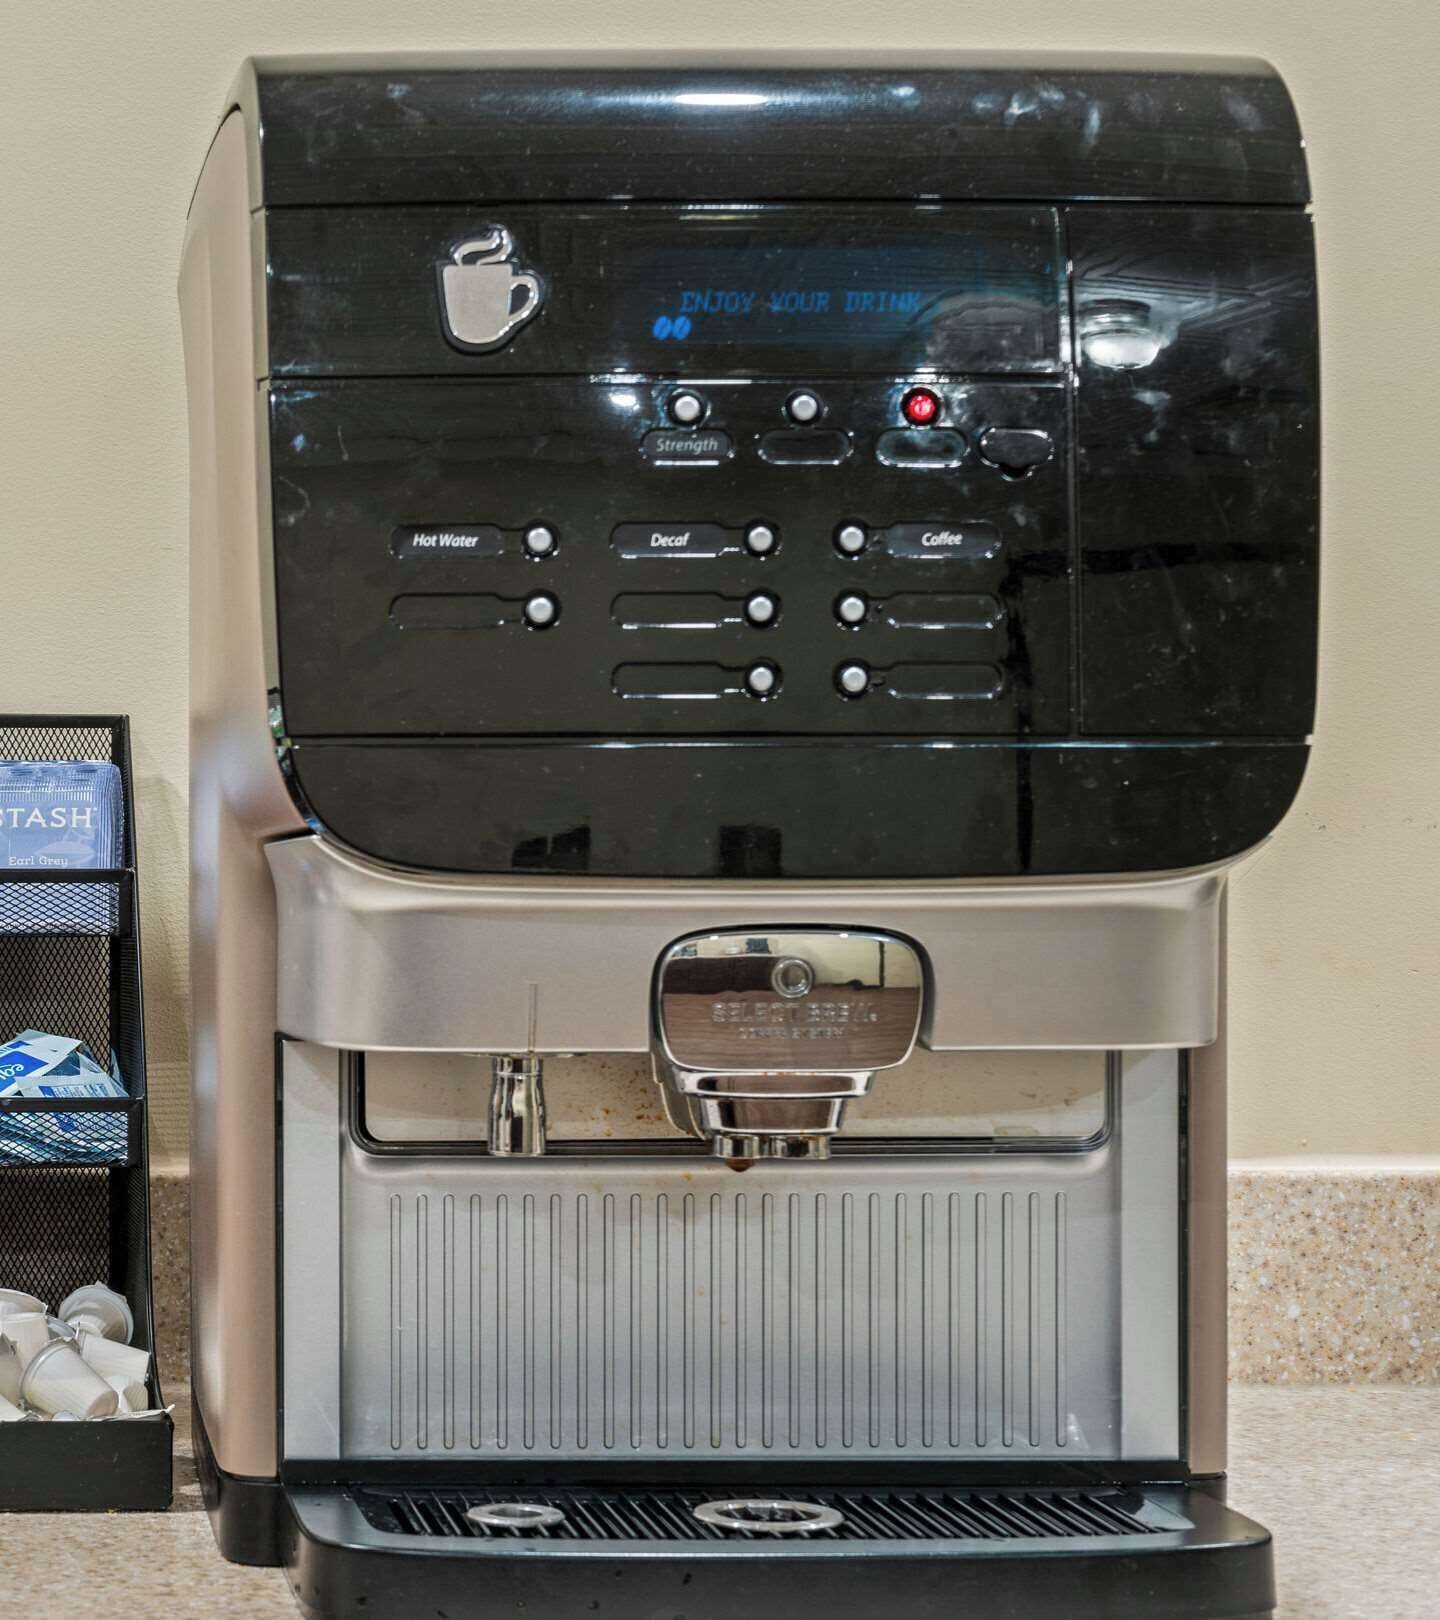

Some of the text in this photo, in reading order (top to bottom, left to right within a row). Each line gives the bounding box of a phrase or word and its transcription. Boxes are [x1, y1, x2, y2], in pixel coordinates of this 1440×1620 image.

[680, 291, 920, 313] ENJOY YOUR DRINK
[656, 437, 718, 454] Strength
[413, 532, 479, 547] Hot Water
[650, 532, 691, 547] Decaf
[921, 530, 963, 547] Coffee
[8, 856, 68, 869] Earl Grey
